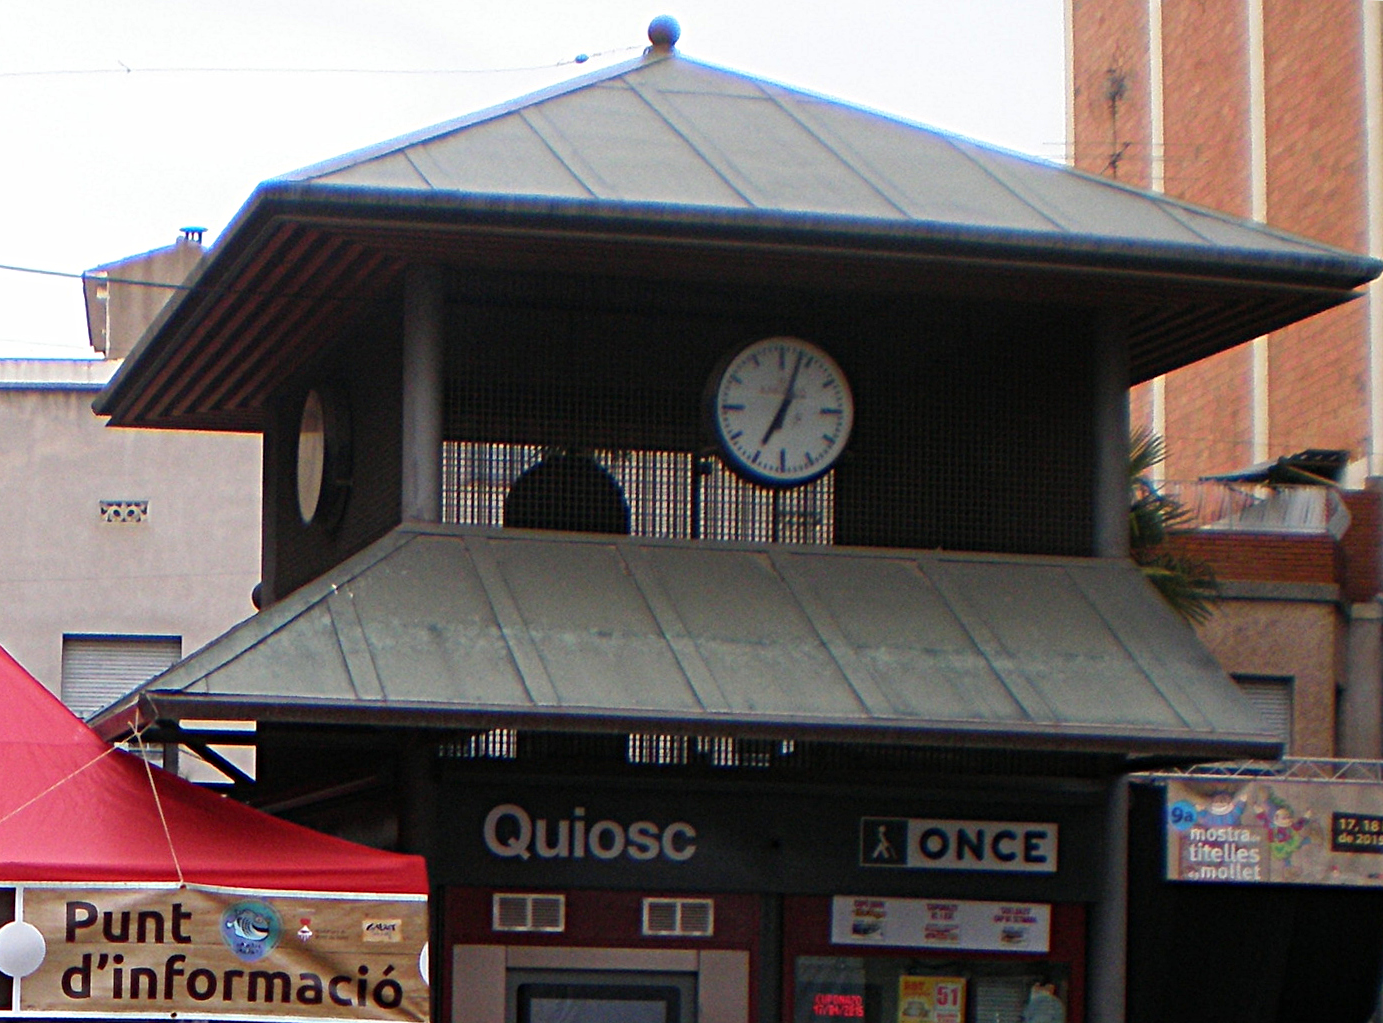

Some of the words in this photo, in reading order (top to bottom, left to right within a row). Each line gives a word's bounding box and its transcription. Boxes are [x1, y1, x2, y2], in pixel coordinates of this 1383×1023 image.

[1171, 807, 1194, 824] 9a
[484, 803, 697, 861] Quiosc
[1190, 826, 1251, 842] mostra
[919, 826, 1048, 864] ONCE
[1189, 842, 1261, 863] titelles
[1200, 864, 1262, 880] mollet
[65, 901, 192, 944] Punt
[61, 952, 404, 1009] d'informació
[936, 985, 959, 1007] 51
